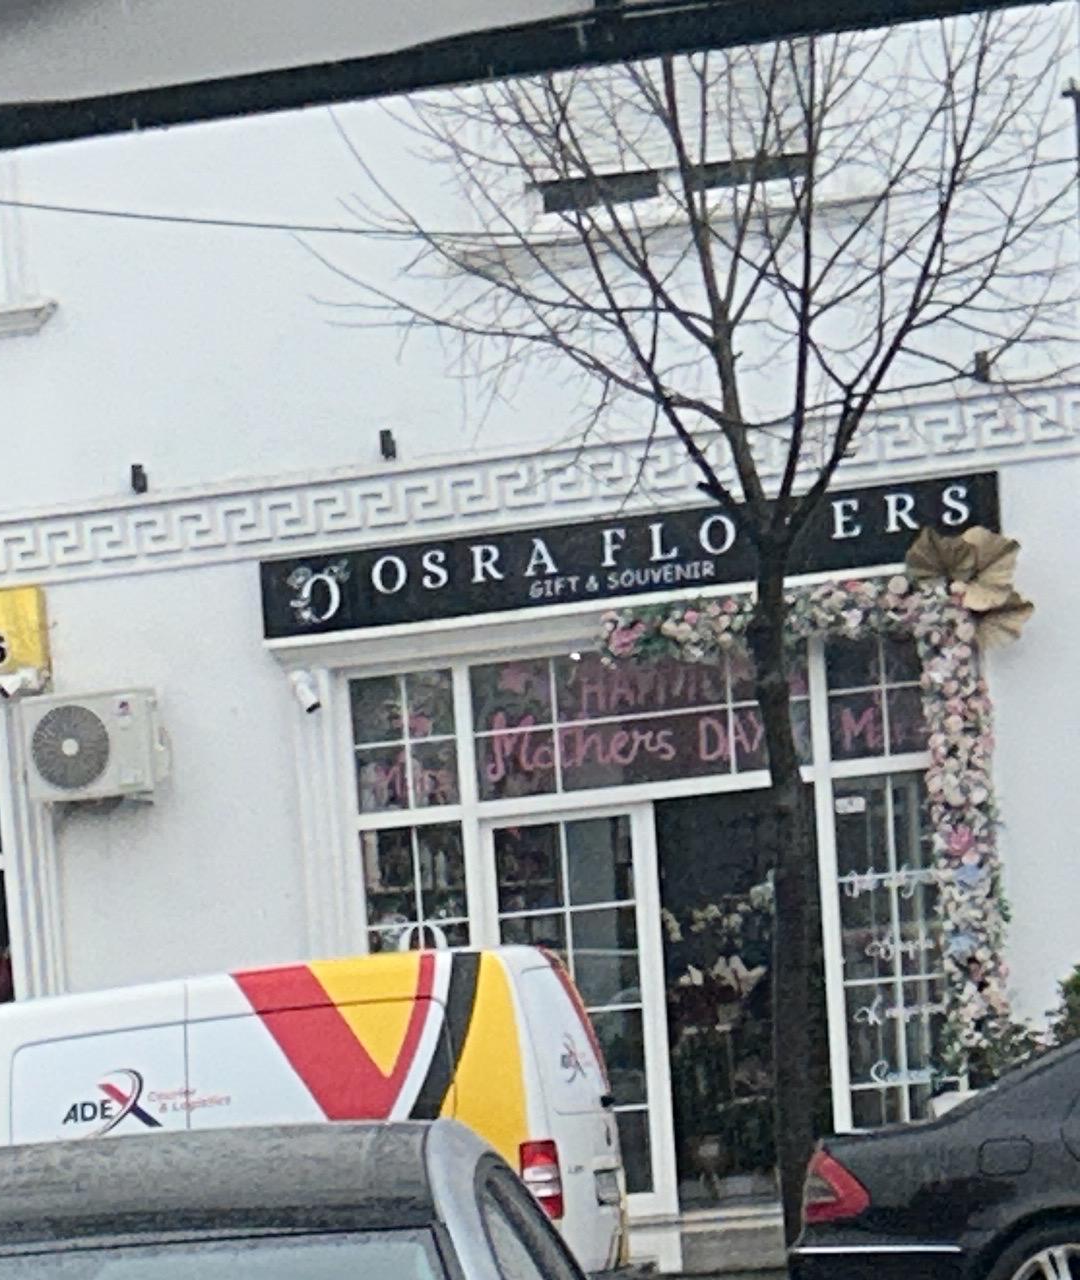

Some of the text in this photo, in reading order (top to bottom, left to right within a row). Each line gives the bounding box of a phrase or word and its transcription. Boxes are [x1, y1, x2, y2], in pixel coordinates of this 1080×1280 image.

[371, 484, 970, 594] OSRA FLOERS
[529, 560, 716, 599] GIFT & SOUVENIR
